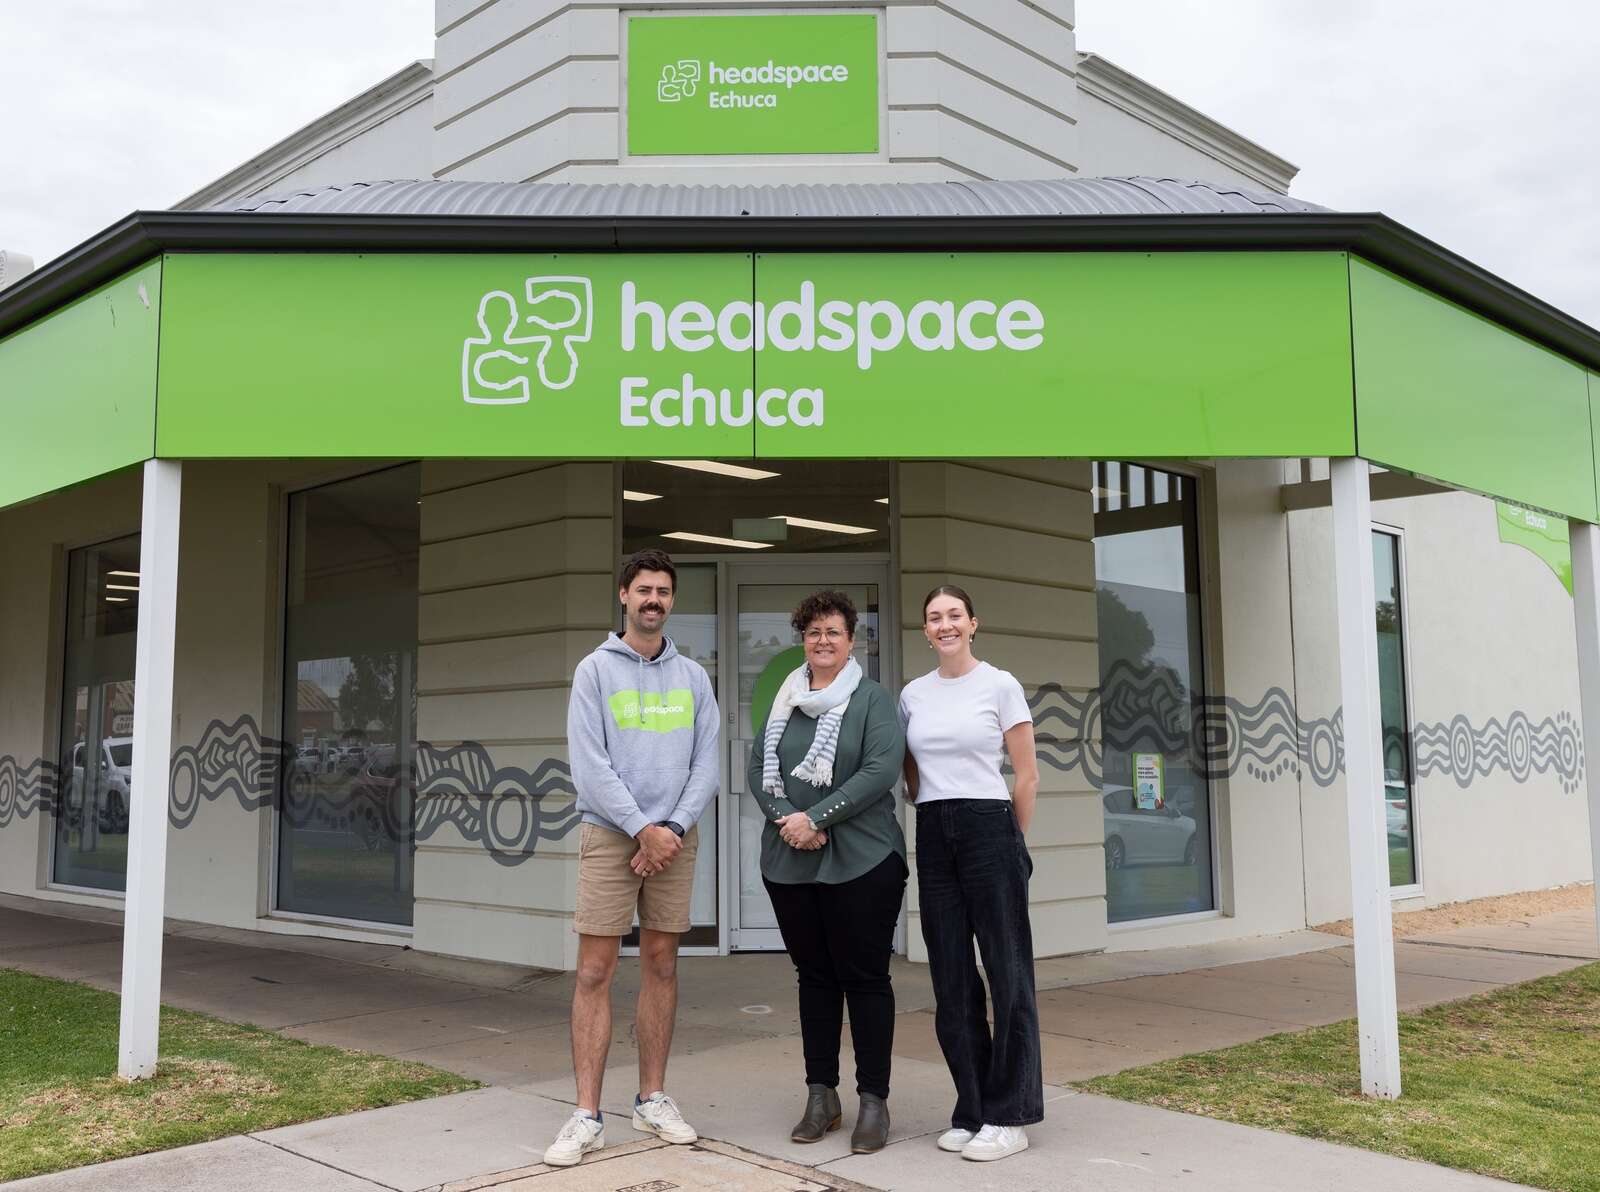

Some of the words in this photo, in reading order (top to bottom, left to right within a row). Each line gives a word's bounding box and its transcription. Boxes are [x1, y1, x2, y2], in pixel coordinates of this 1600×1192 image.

[709, 60, 849, 89] headspace
[709, 91, 777, 109] Echuca
[621, 280, 1045, 370] headspace
[620, 373, 824, 427] Echuca
